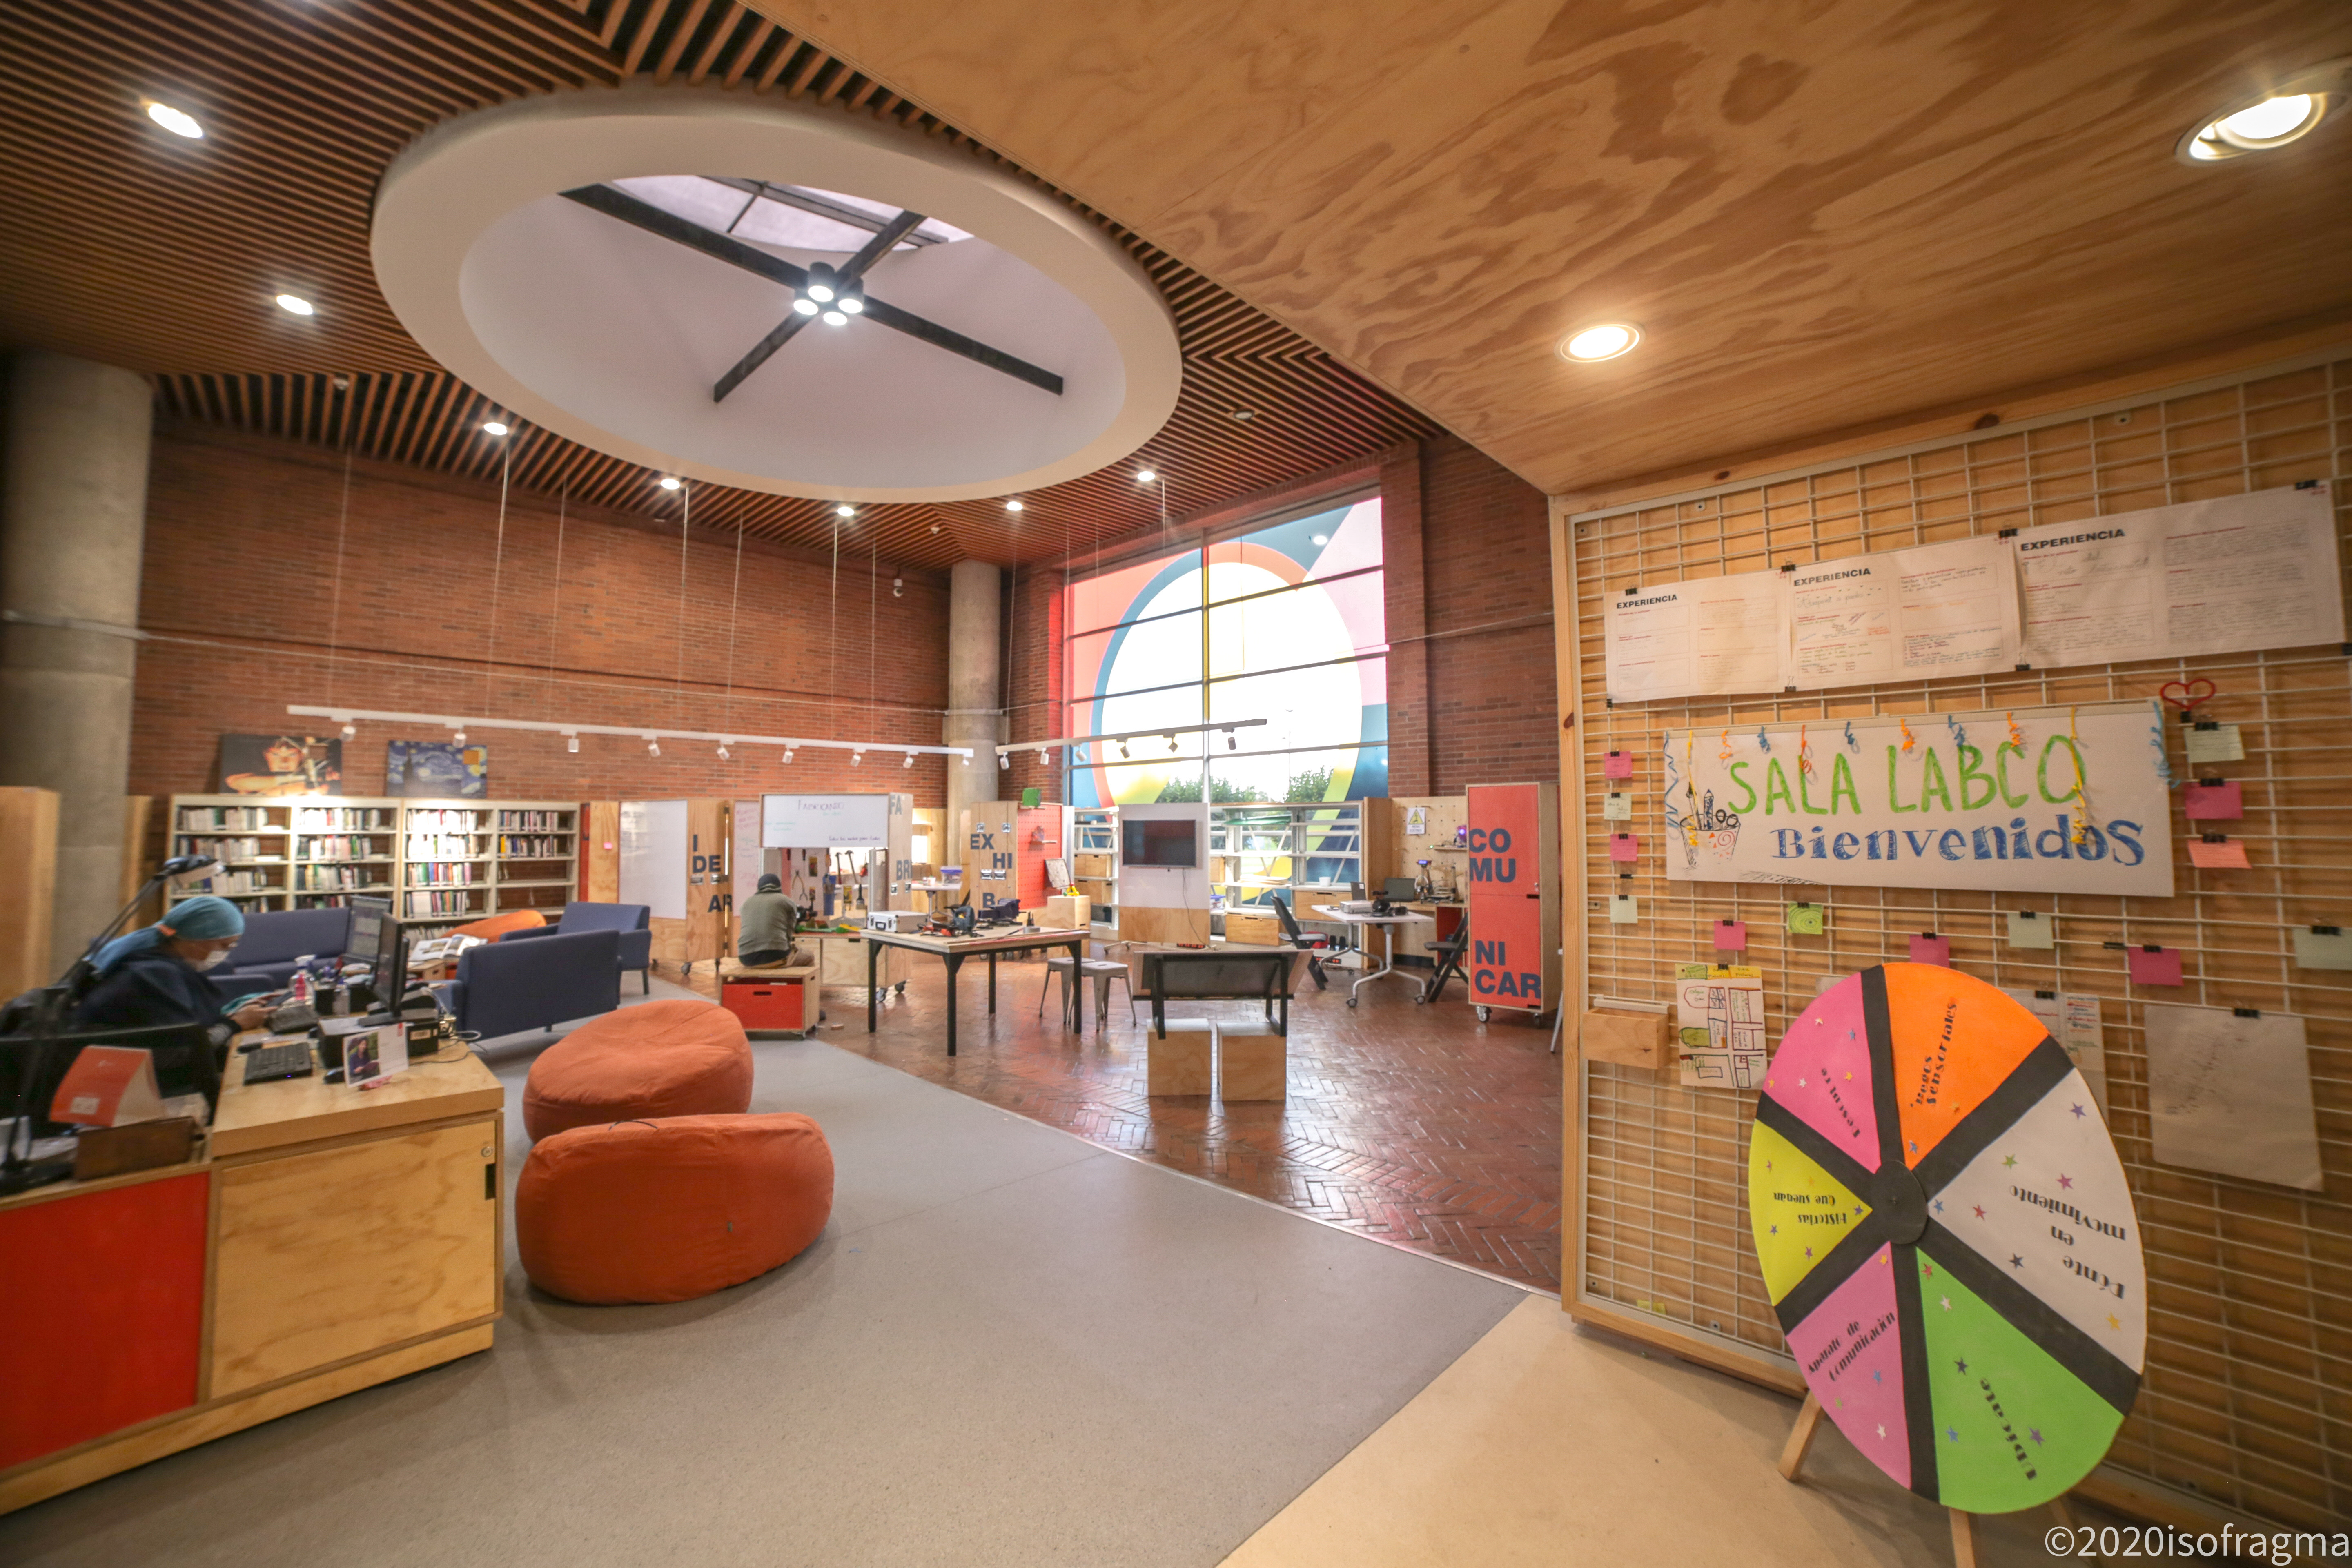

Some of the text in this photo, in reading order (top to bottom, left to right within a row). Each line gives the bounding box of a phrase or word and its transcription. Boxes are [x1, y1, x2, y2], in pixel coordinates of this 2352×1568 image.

[2021, 529, 2126, 551] EXPERIENCIA
[1794, 568, 1871, 586] EXPERIENCIA
[1617, 594, 1677, 609] EXPERIENCIA
[1728, 734, 2085, 816] SALA LABCO
[971, 834, 994, 849] EX
[1469, 828, 1511, 853] CO
[1771, 814, 2145, 866] Bienvenidos
[693, 855, 721, 873] DE
[993, 853, 1012, 869] HI
[1470, 858, 1516, 882] MU
[1475, 941, 1506, 965] NI
[1475, 969, 1541, 998] CAR
[2051, 1226, 2074, 1246] en
